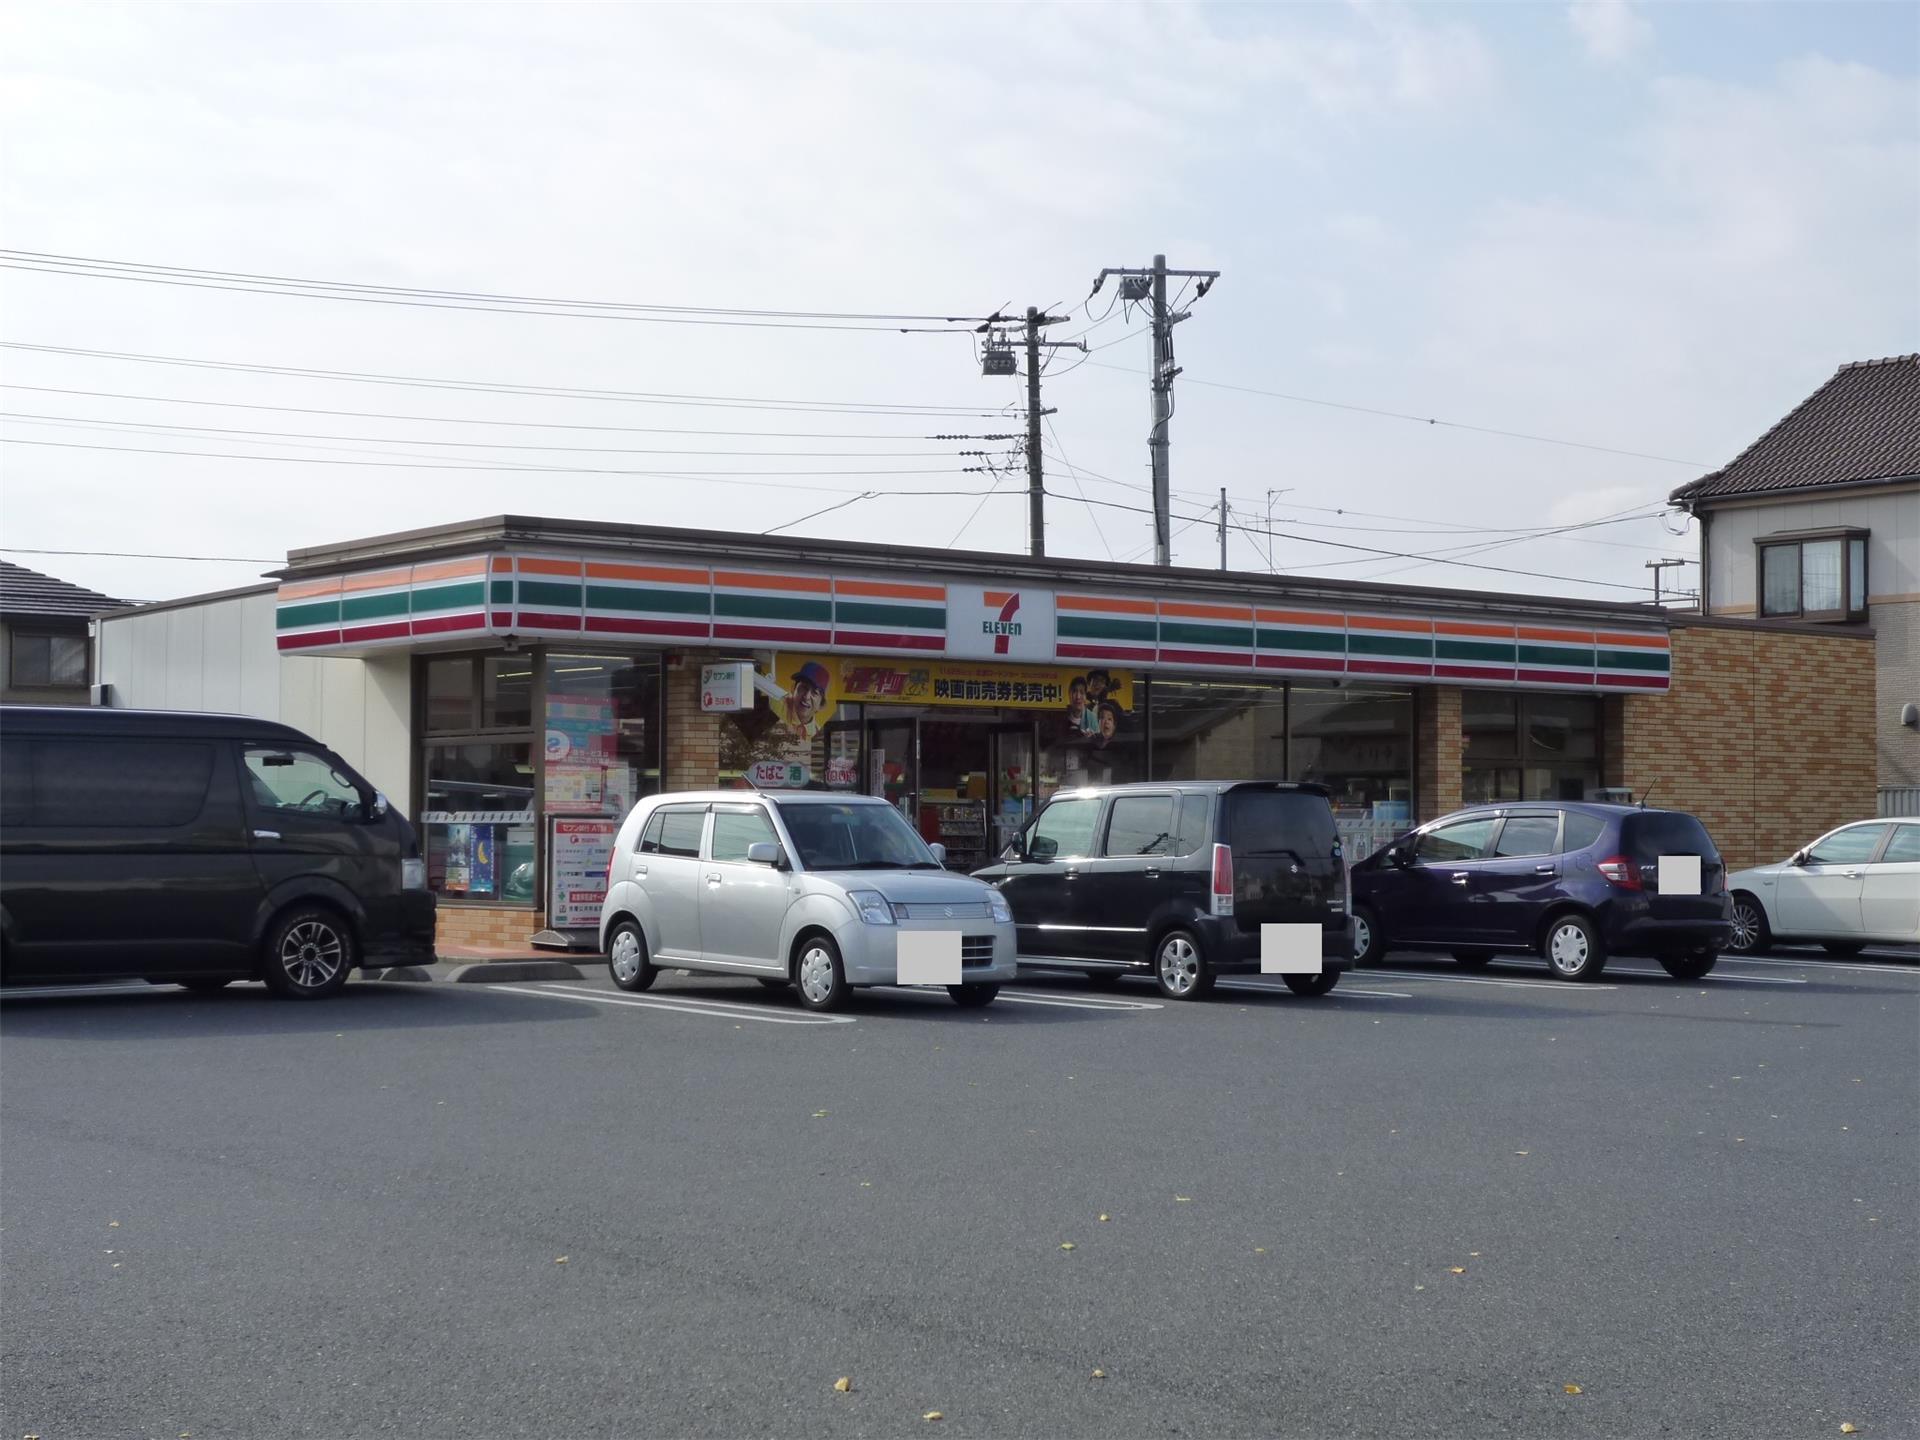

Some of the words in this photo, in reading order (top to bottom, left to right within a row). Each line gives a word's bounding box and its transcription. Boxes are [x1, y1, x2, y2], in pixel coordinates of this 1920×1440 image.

[755, 765, 785, 780] たばこ
[789, 765, 802, 781] 酒
